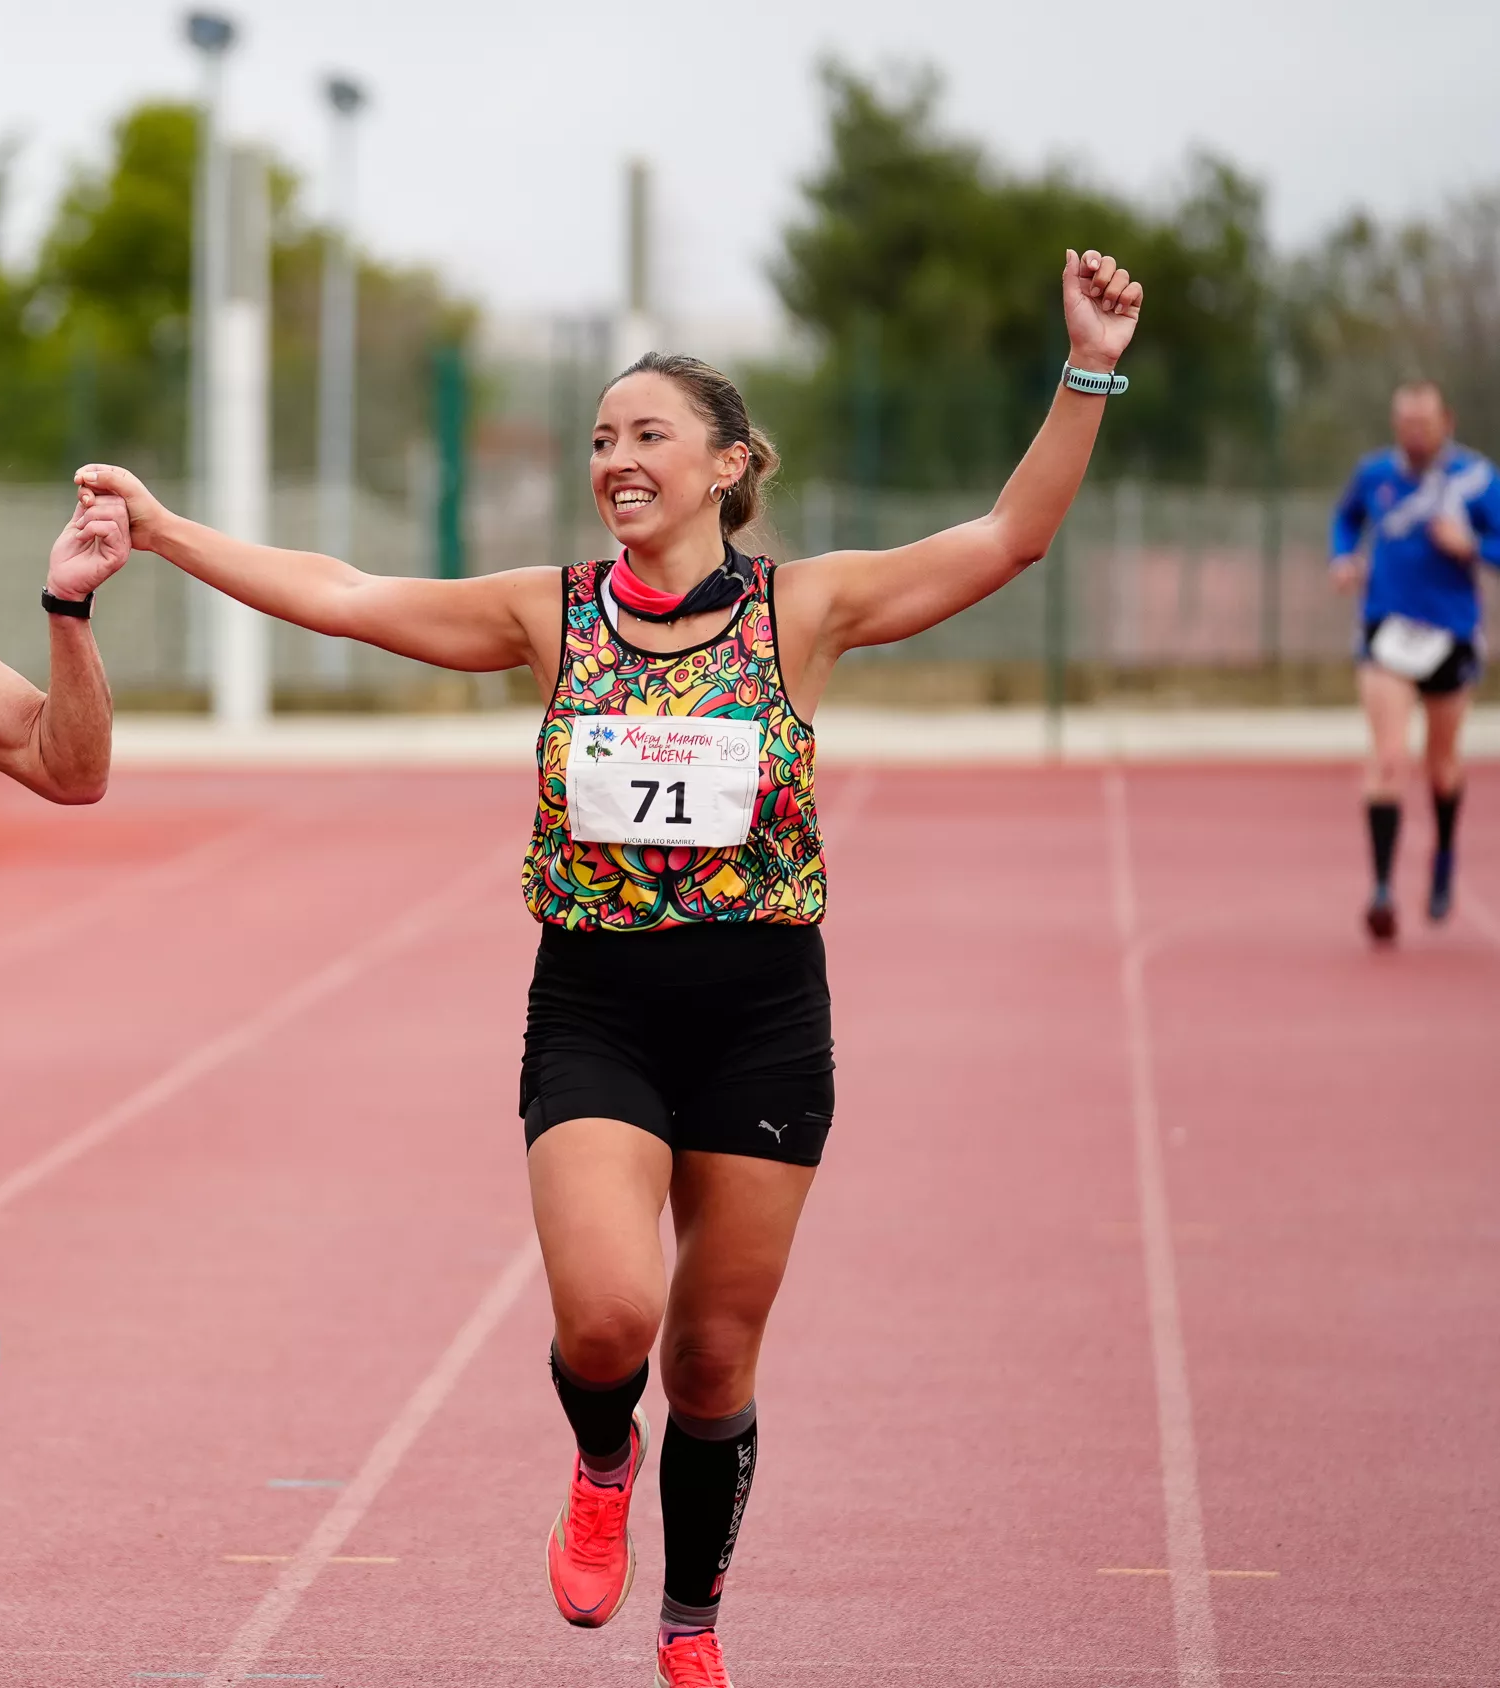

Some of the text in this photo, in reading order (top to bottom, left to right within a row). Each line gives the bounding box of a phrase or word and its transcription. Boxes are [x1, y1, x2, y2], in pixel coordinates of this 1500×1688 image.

[620, 726, 640, 748] X
[635, 731, 660, 745] MEDIA
[641, 745, 699, 765] LUCENA
[631, 780, 692, 824] 71
